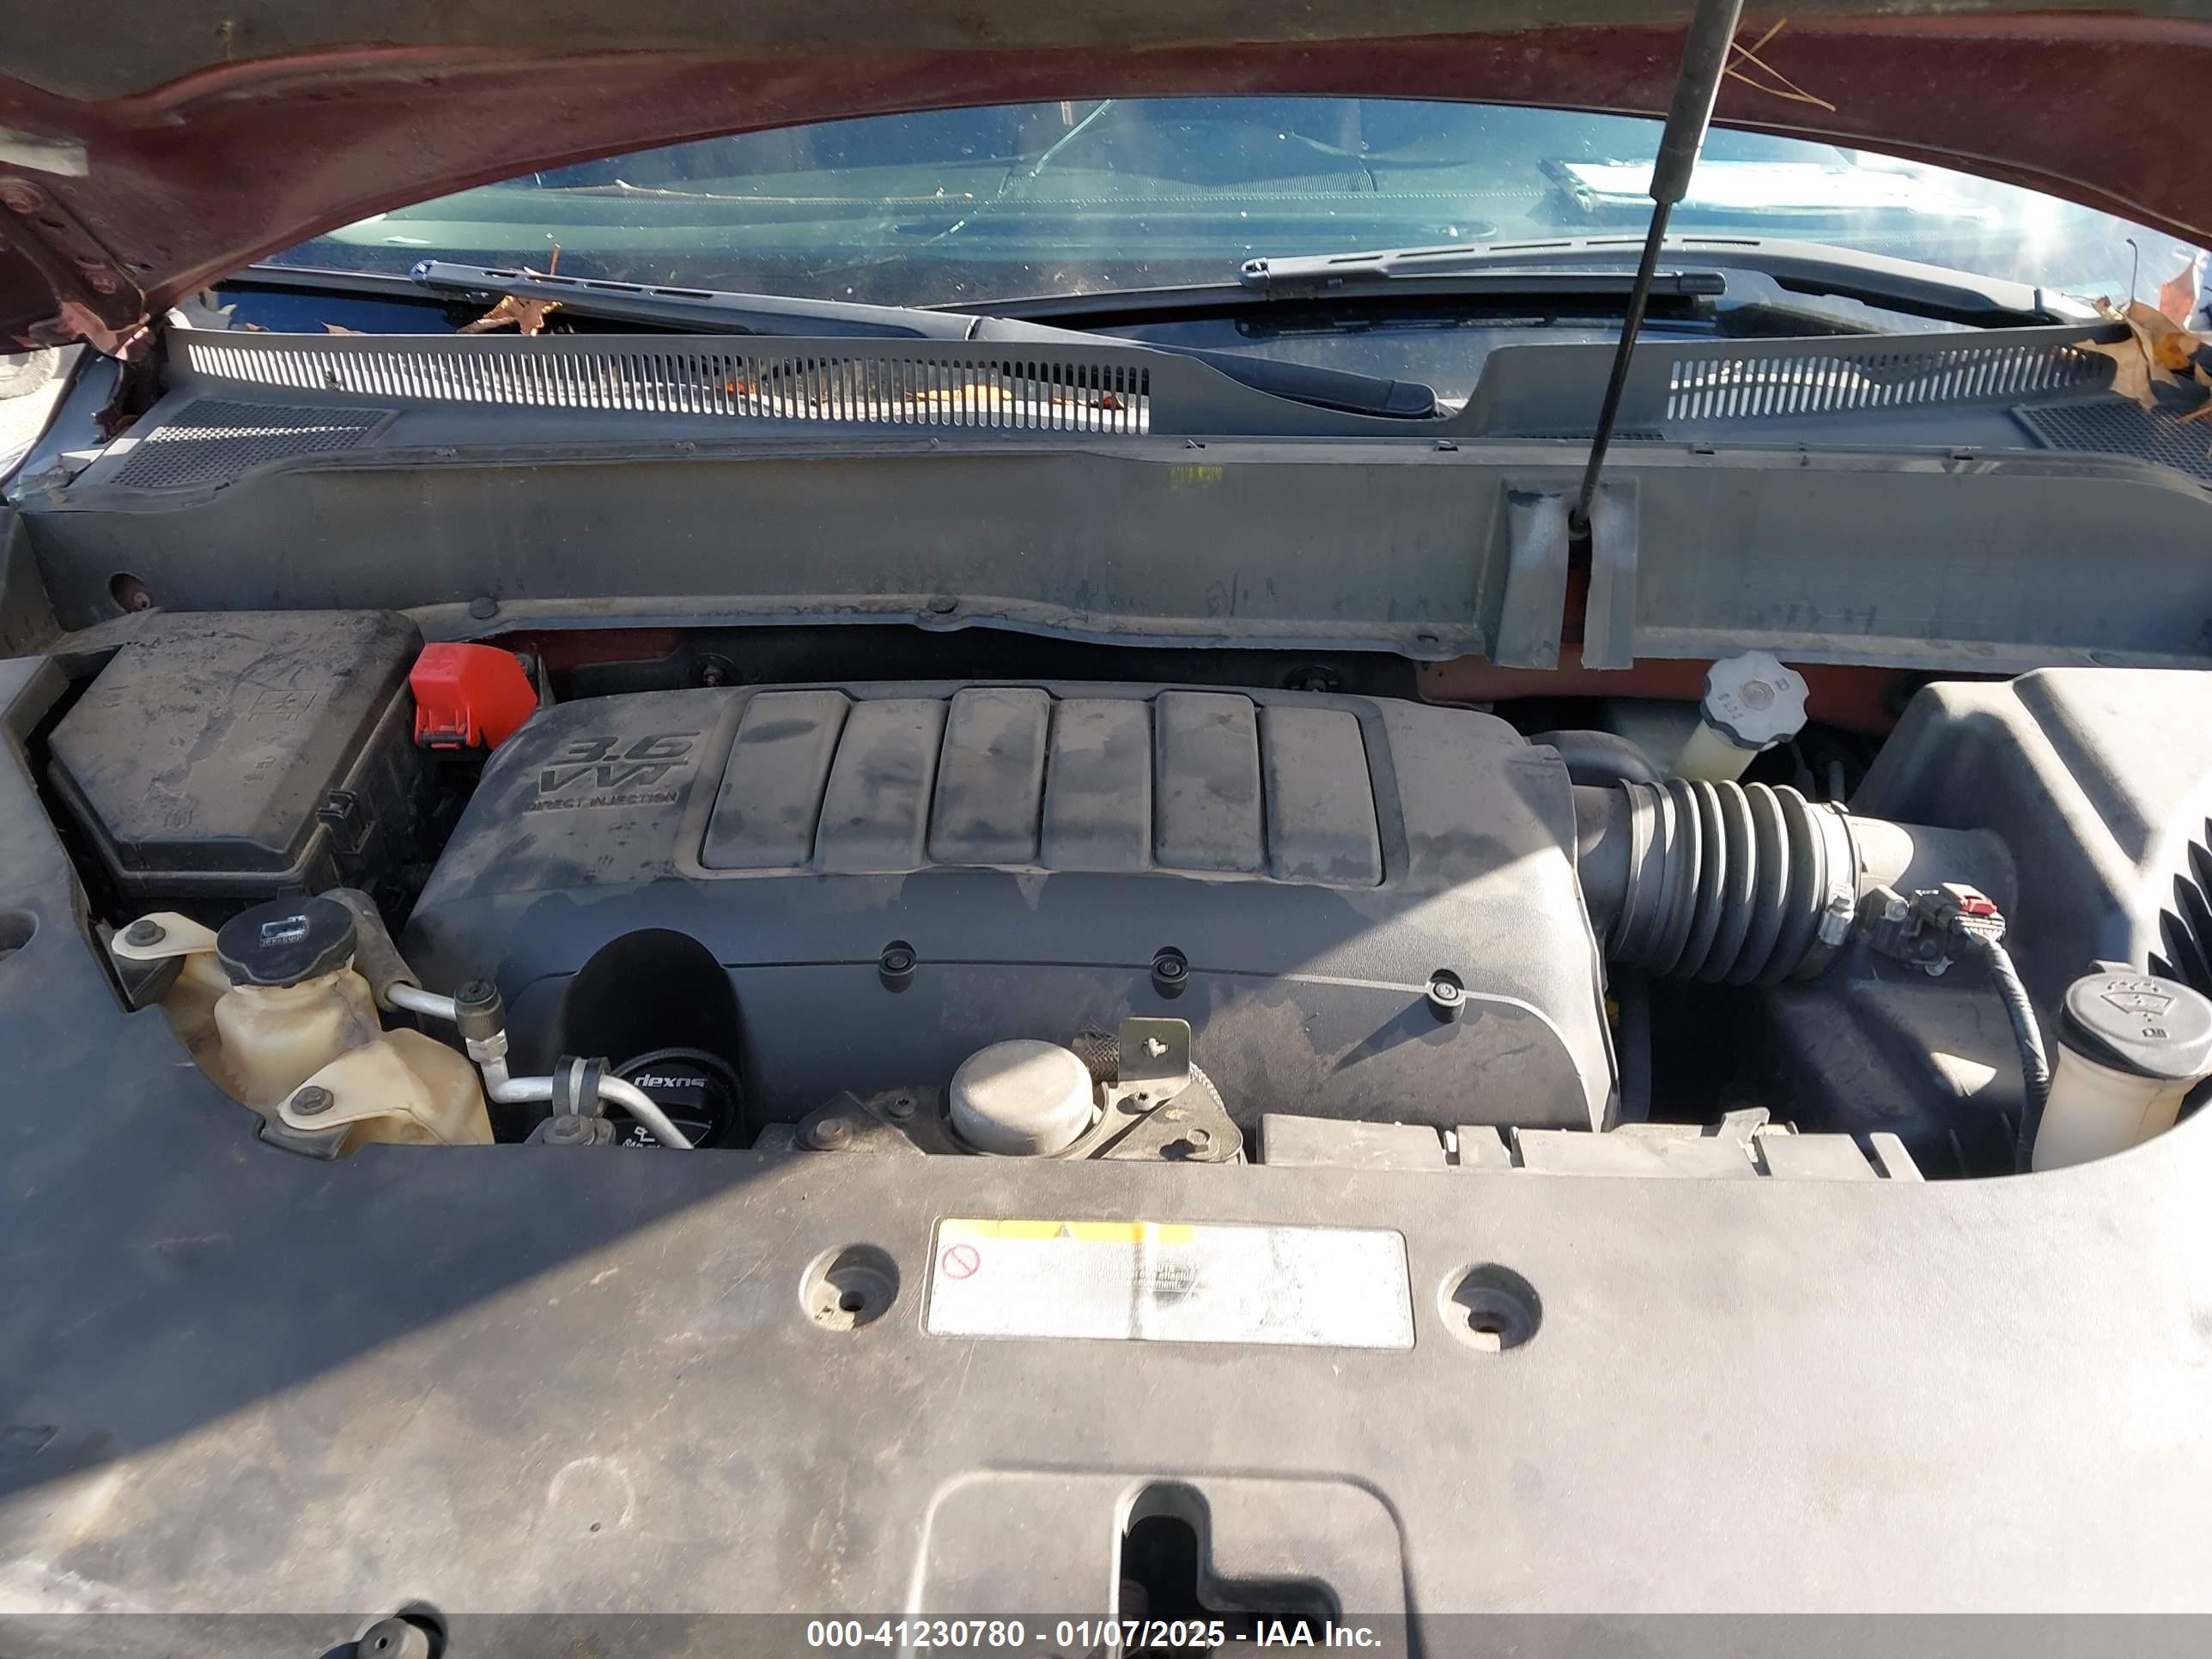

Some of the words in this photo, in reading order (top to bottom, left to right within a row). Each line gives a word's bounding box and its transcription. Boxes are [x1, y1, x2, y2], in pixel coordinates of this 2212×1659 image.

[545, 731, 701, 767] 3.6
[526, 798, 583, 811] DIRECT
[589, 792, 678, 808] INJECTION
